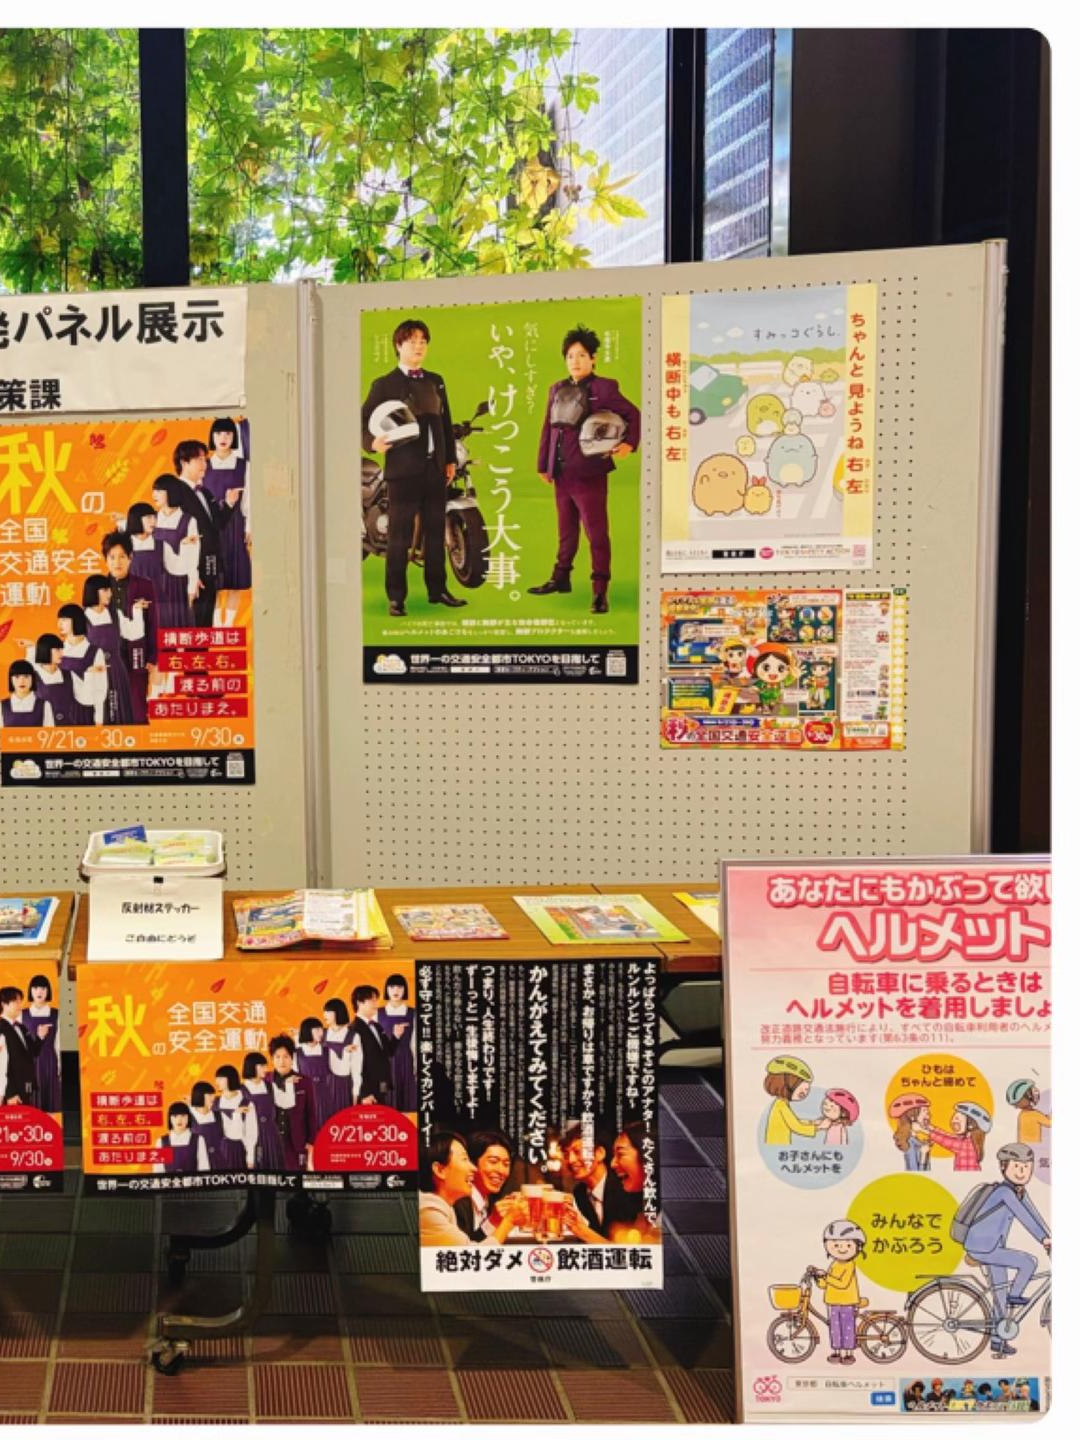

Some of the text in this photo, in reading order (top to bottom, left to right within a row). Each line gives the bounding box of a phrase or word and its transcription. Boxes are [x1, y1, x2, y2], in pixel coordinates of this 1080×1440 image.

[0, 548, 104, 576] 交通安全
[0, 581, 52, 608] 運動
[121, 901, 200, 915] 反射材ステッカー
[821, 911, 1046, 958] ヘルメット
[828, 971, 1043, 995] 自転車に乗るときは
[167, 1000, 268, 1026] 全国交通
[87, 995, 167, 1058] 秋の
[168, 1028, 268, 1054] 安全運動
[528, 964, 549, 1174] かんがえてみてください。
[921, 1063, 956, 1076] ひもは
[777, 1151, 844, 1162] お子さんにも
[780, 1163, 843, 1174] ヘルメットを
[871, 1212, 944, 1230] みんなで
[871, 1236, 944, 1255] かぶろう
[436, 1246, 653, 1274] 絶対ダメ 飲酒運転
